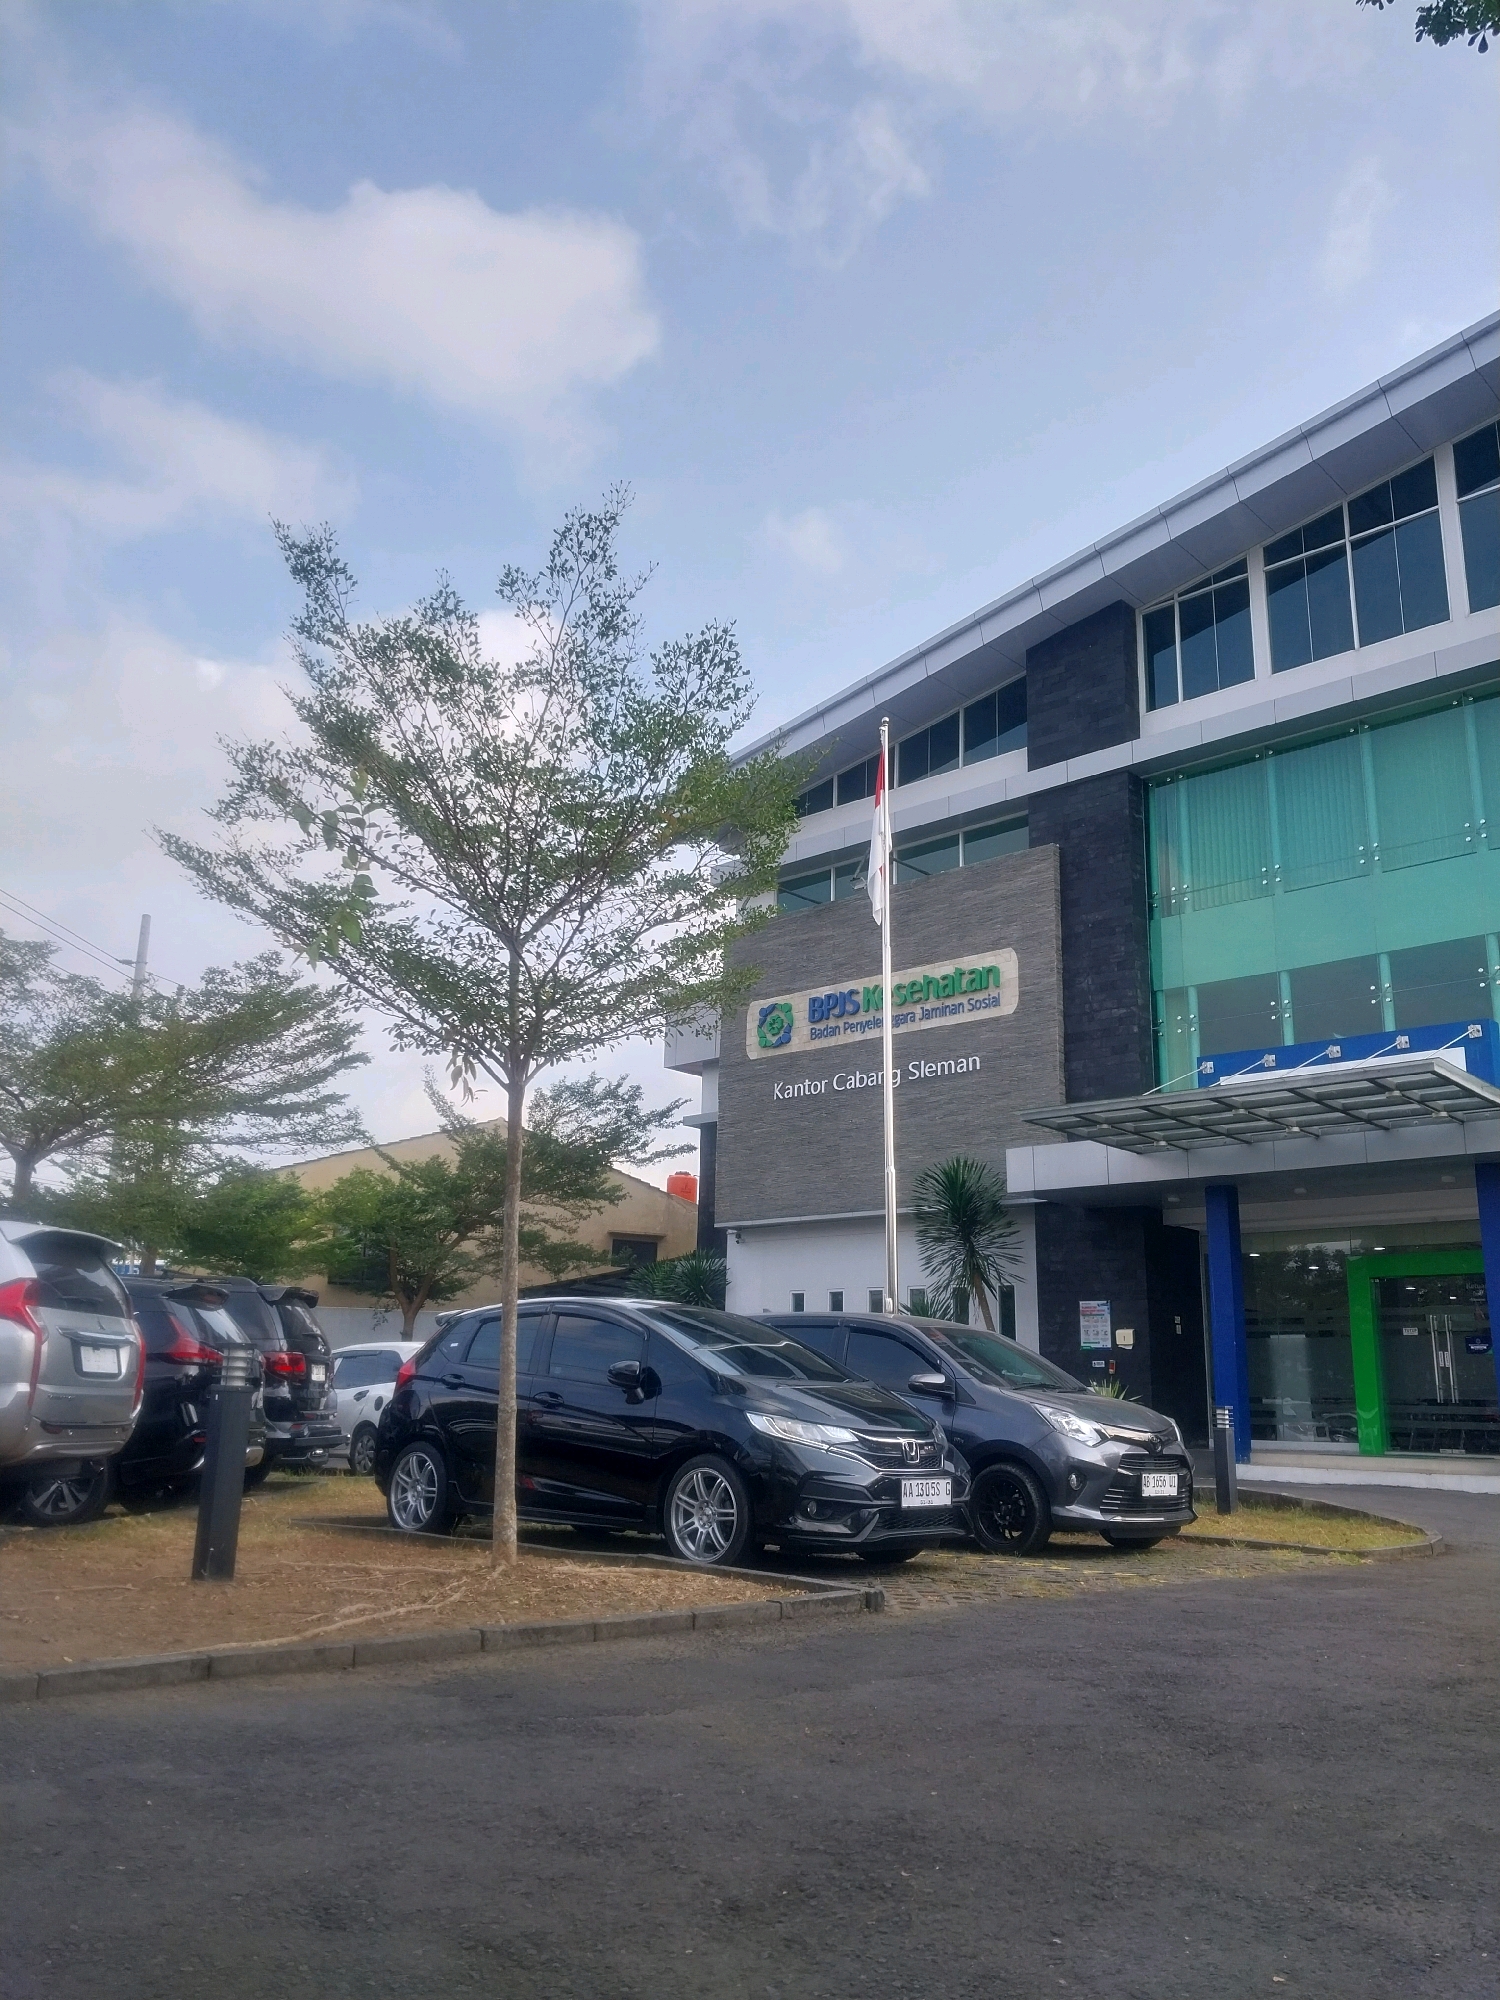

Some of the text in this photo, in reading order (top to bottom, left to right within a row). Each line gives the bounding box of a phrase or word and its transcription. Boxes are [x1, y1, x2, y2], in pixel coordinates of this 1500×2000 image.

[808, 988, 861, 1024] BPJS
[810, 992, 1001, 1041] Badan Penyelegara Jaminan Sosial
[773, 1078, 829, 1101] Kantor
[908, 1055, 981, 1081] Sleman
[903, 1482, 914, 1498] AA
[1143, 1475, 1151, 1488] AB
